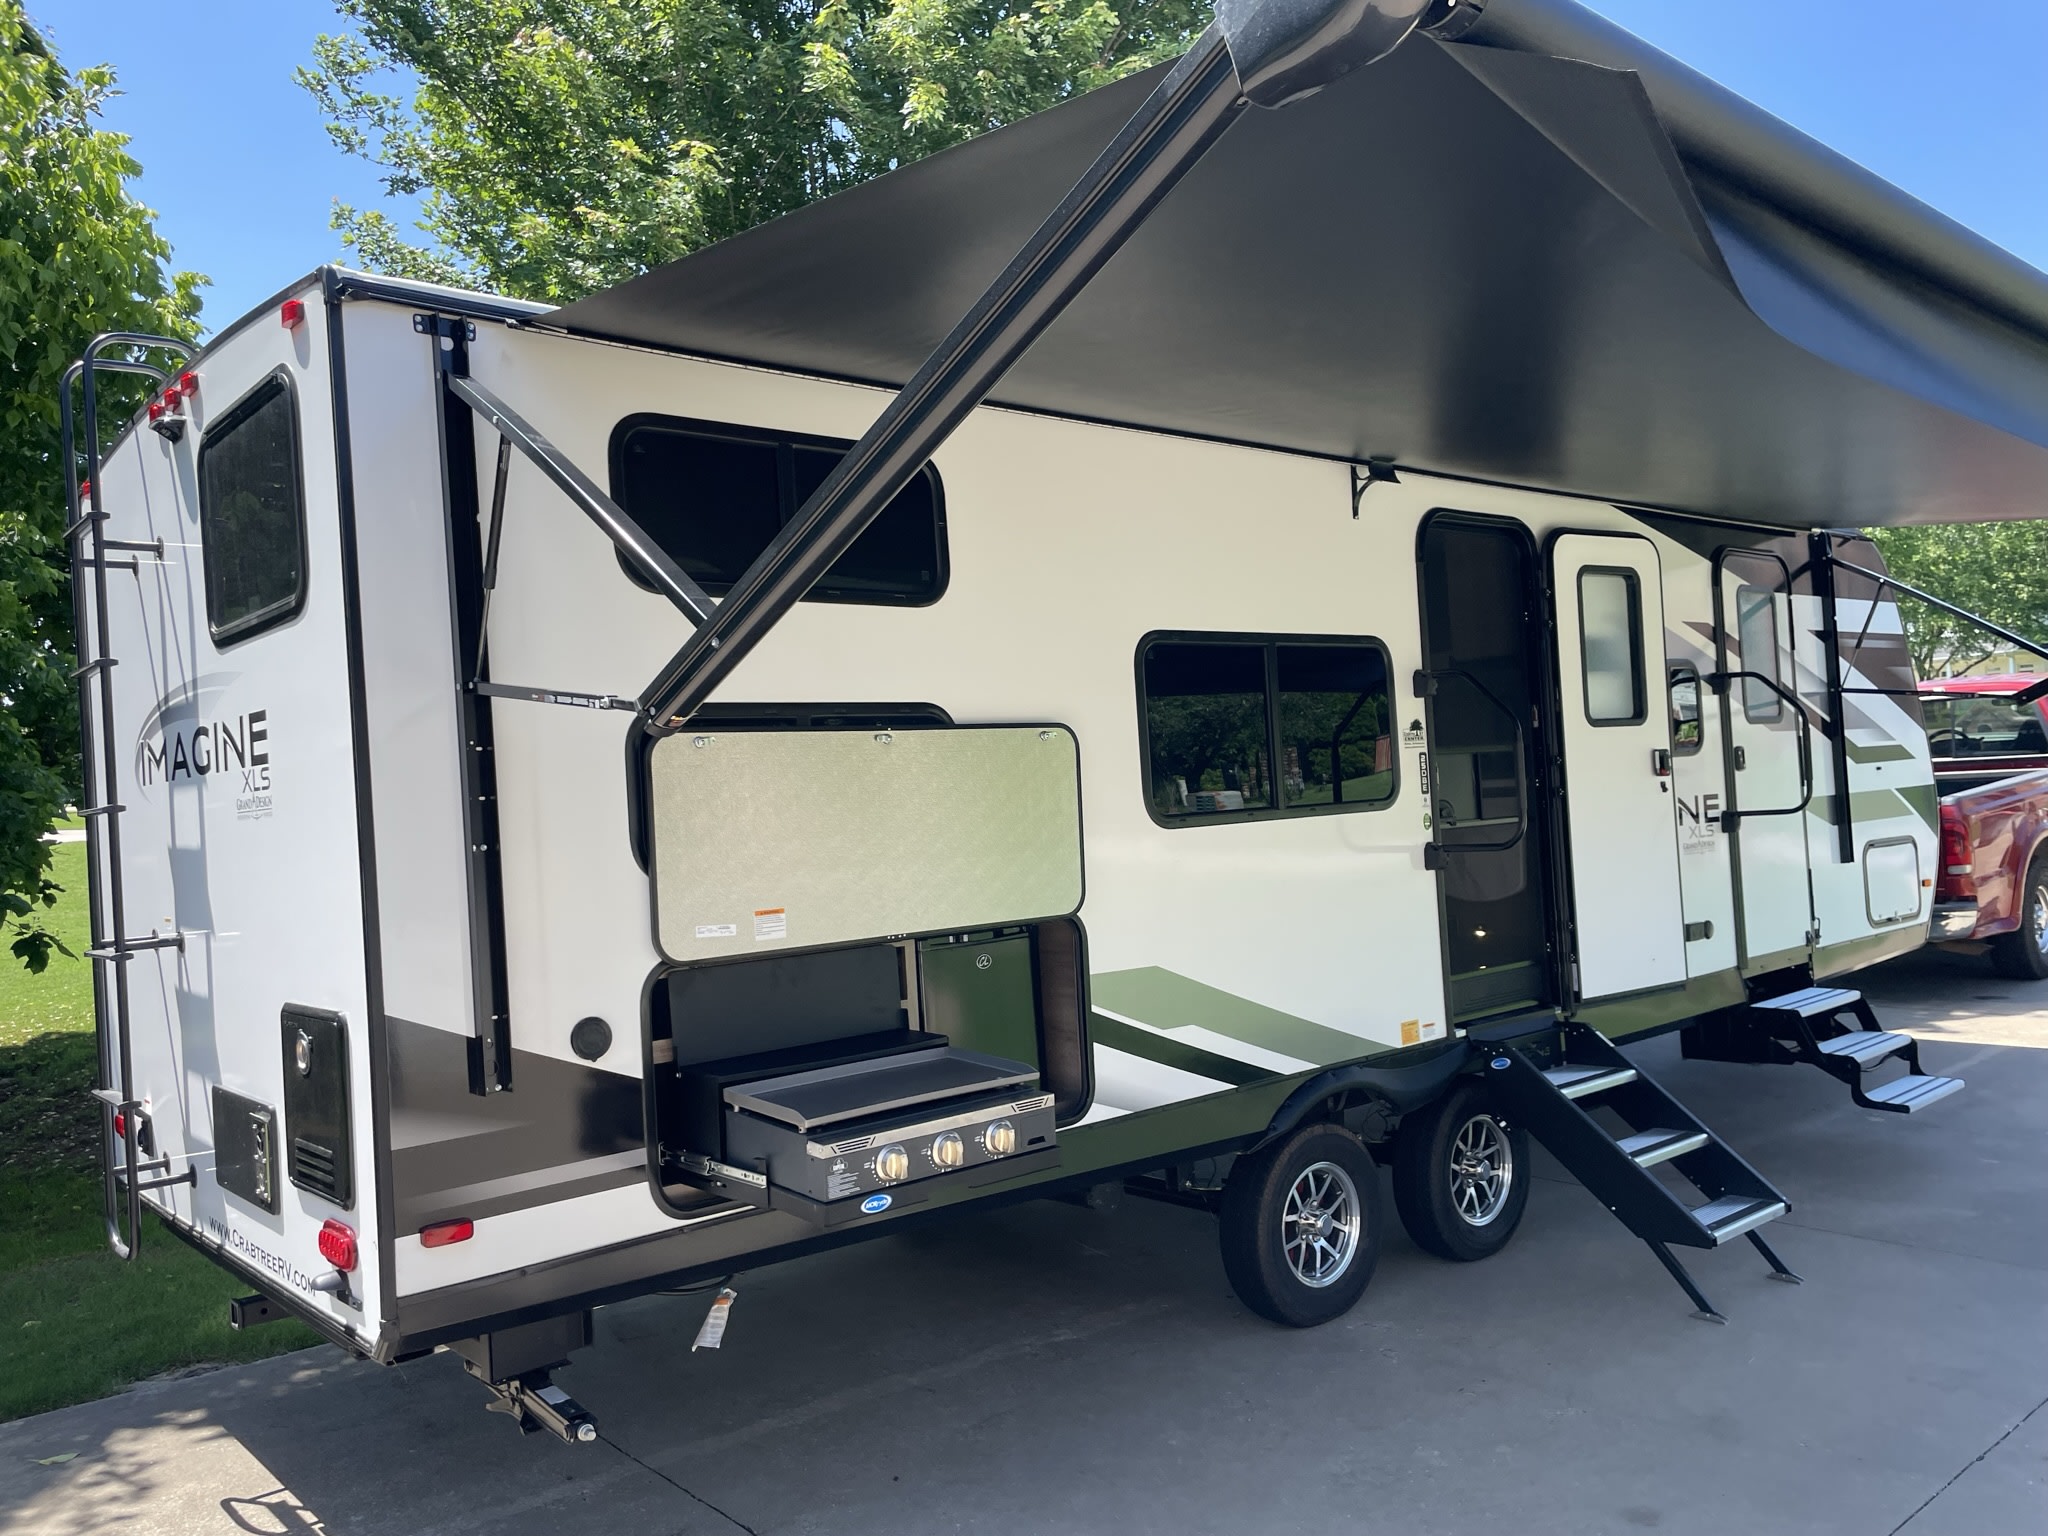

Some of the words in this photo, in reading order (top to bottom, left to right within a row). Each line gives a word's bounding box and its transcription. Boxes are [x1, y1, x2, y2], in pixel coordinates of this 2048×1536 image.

[140, 709, 269, 786] IMAGINE
[242, 767, 271, 794] XLS
[1689, 824, 1714, 839] XLS
